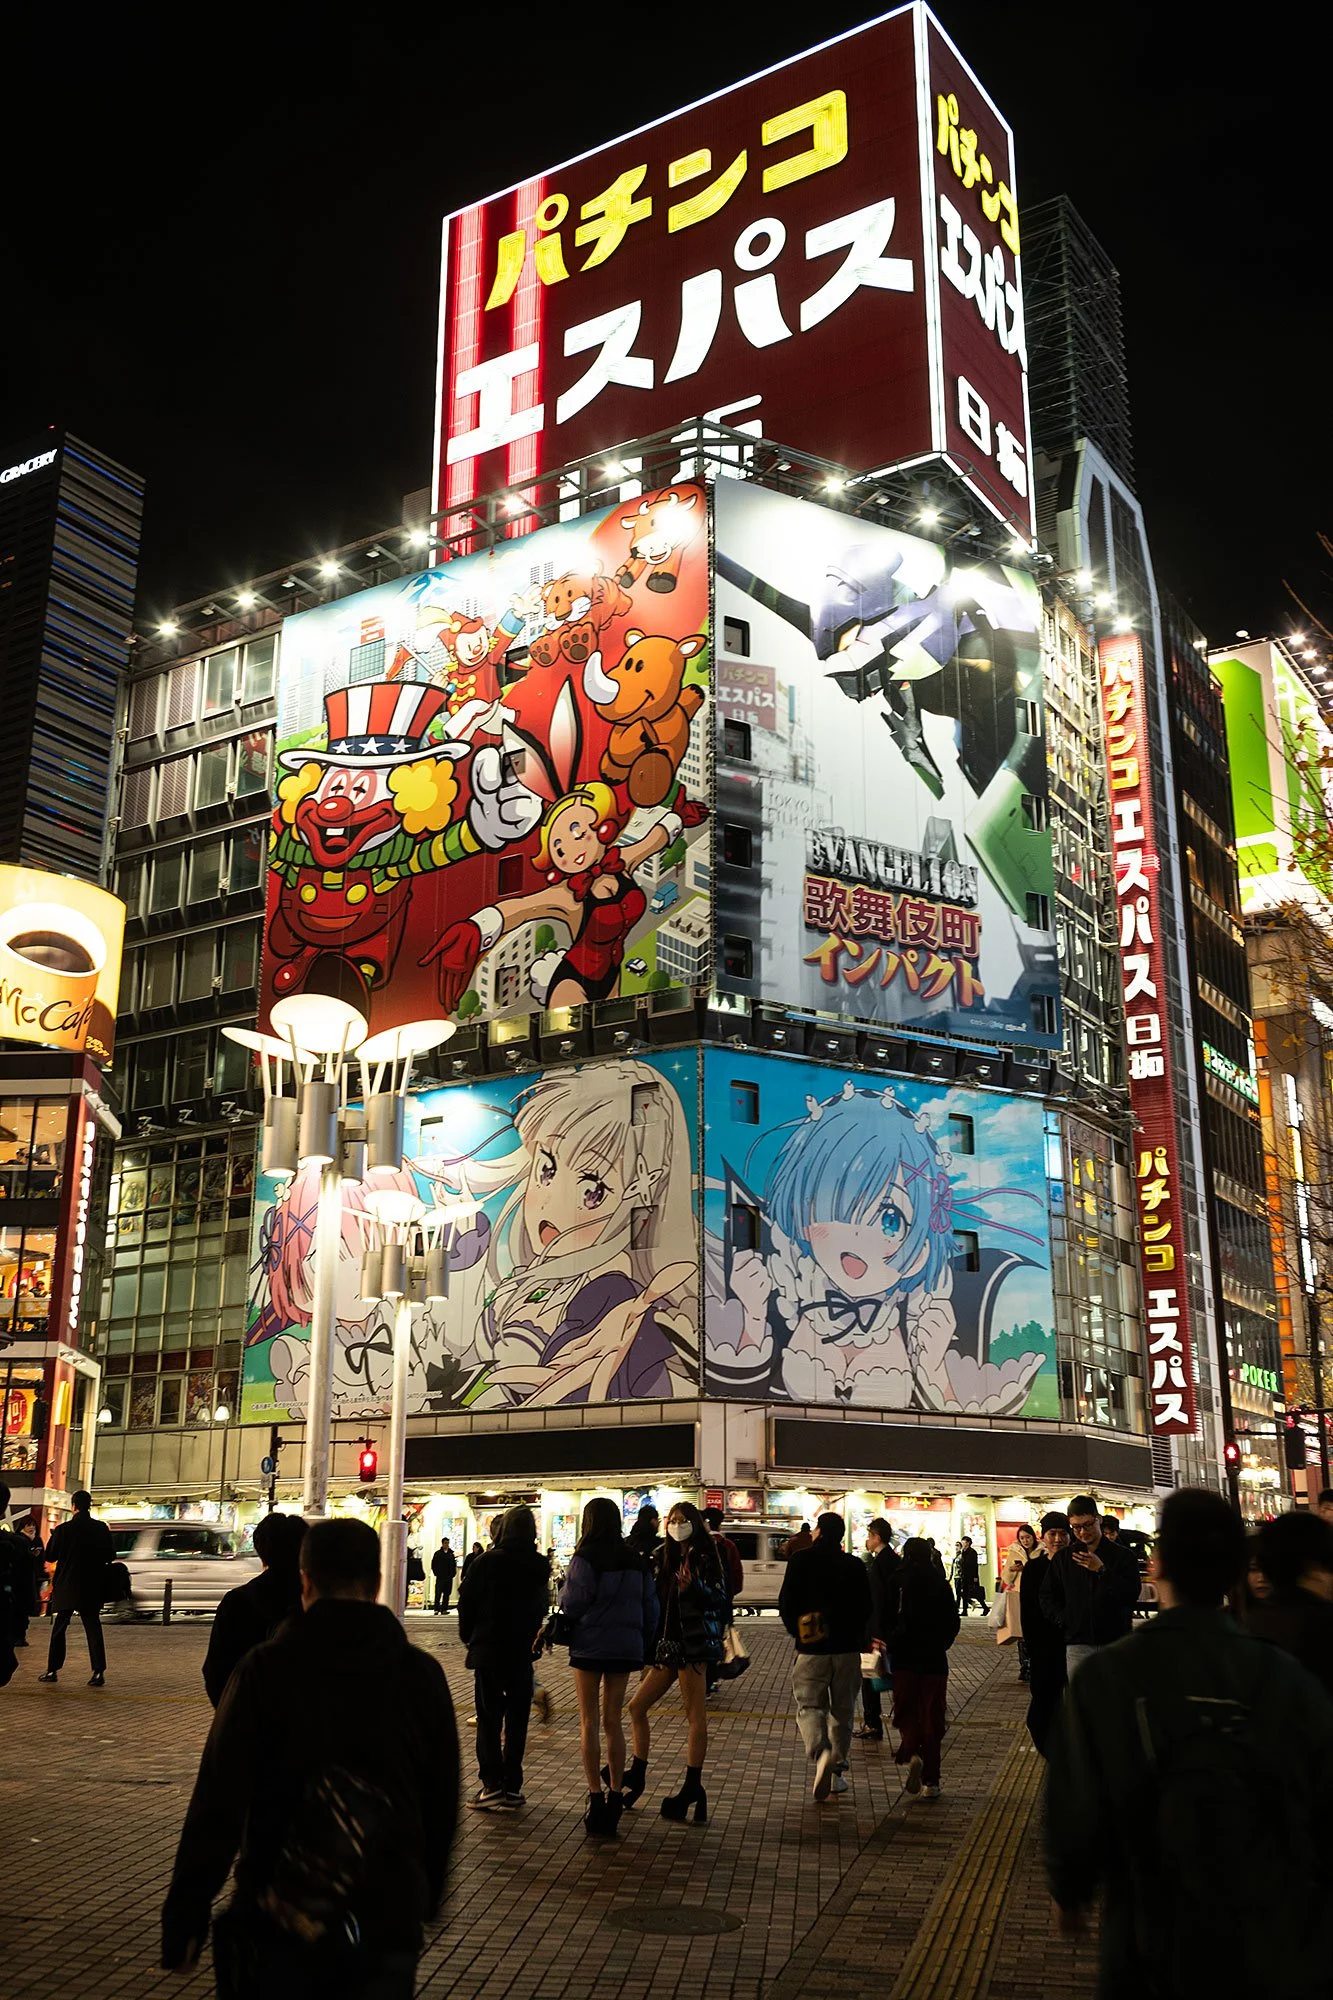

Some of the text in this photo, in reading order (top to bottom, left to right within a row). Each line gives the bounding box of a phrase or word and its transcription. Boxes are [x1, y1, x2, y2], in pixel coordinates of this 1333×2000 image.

[485, 90, 848, 312] パチンコ
[936, 93, 1021, 256] パチンコ
[447, 197, 914, 466] エスパス
[940, 194, 1028, 373] エスパス
[0, 448, 58, 484] GRACERY
[718, 685, 775, 708] エスパス
[1103, 652, 1140, 790] パチンコ
[804, 873, 982, 958] 歌舞伎町
[805, 829, 979, 908] EVANGELION
[1113, 799, 1157, 1002] エスパス
[803, 932, 986, 1008] インパクト
[1138, 1148, 1189, 1427] パチンコ エスパス
[1242, 1362, 1279, 1393] POKER
